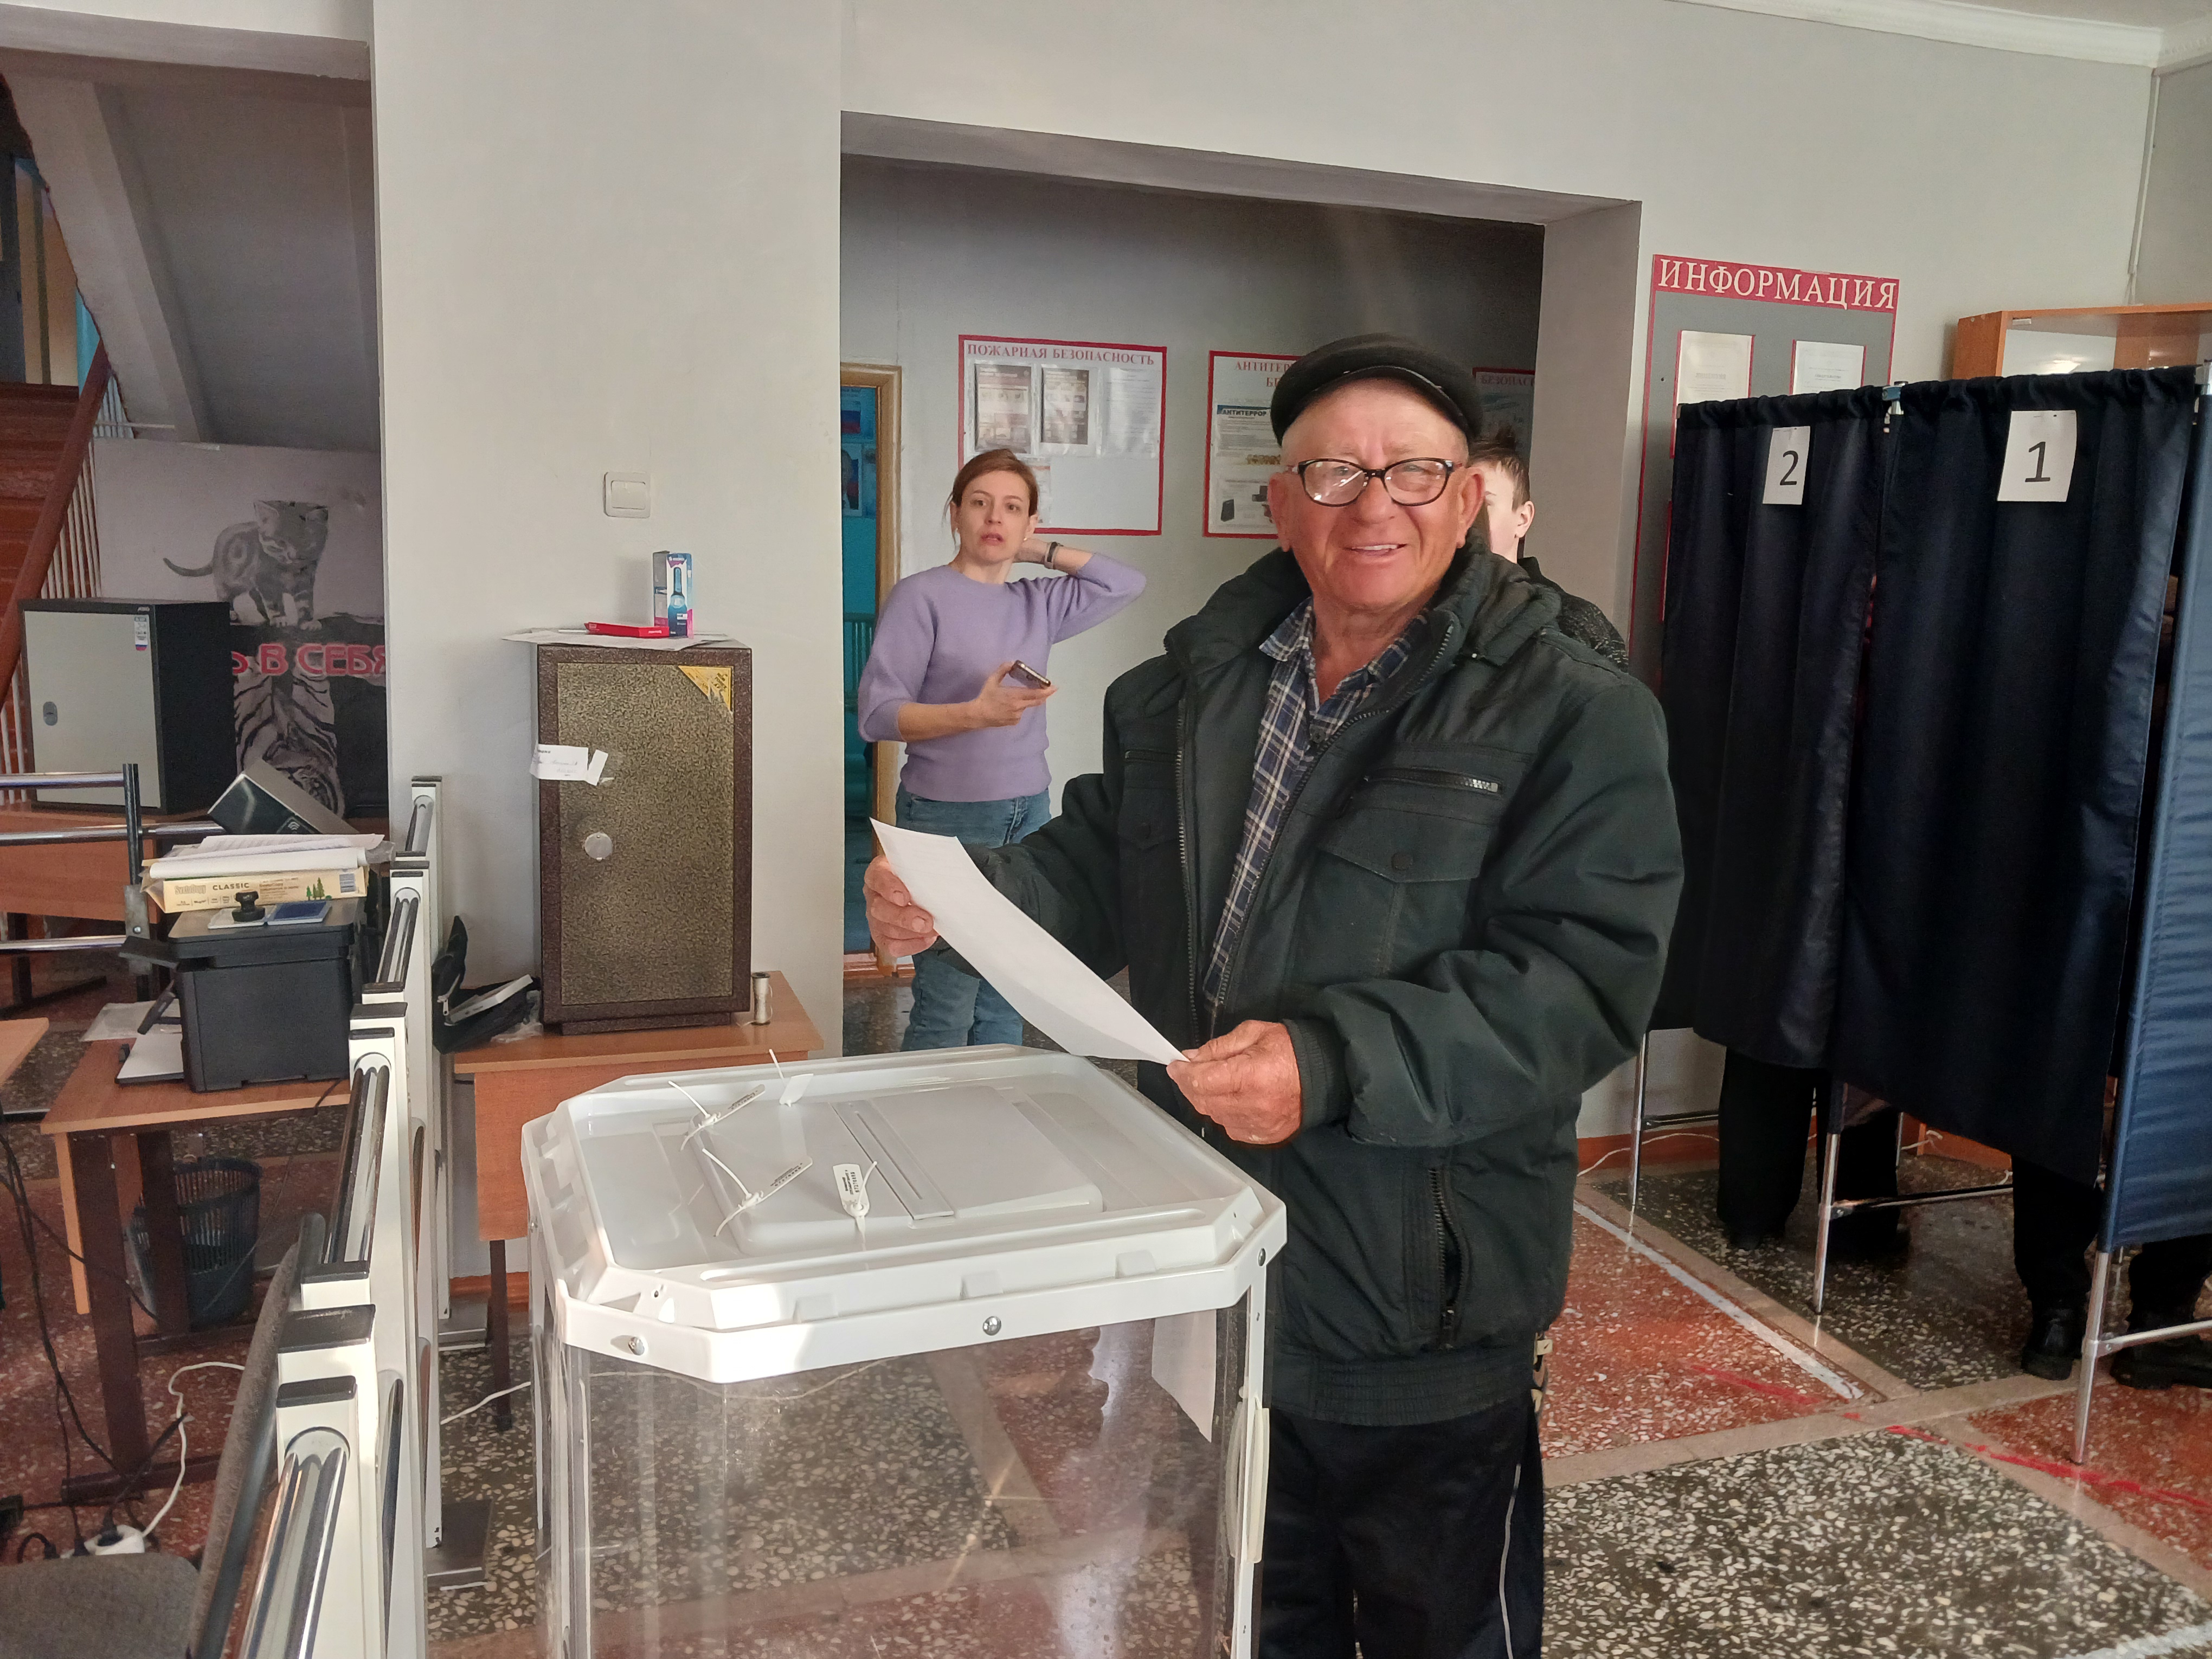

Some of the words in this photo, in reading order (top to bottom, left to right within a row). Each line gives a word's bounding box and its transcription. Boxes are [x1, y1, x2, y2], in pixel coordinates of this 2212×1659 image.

[1658, 259, 1896, 310] ИНФОРМАЦИЯ
[968, 344, 1047, 358] ПОЖАРНАЯ
[1053, 349, 1154, 365] БЕЗОПАСНОСТЬ
[1236, 361, 1294, 372] АНТИТЕР
[1779, 451, 1799, 485] 2
[2024, 441, 2050, 483] 1
[259, 642, 288, 676] В
